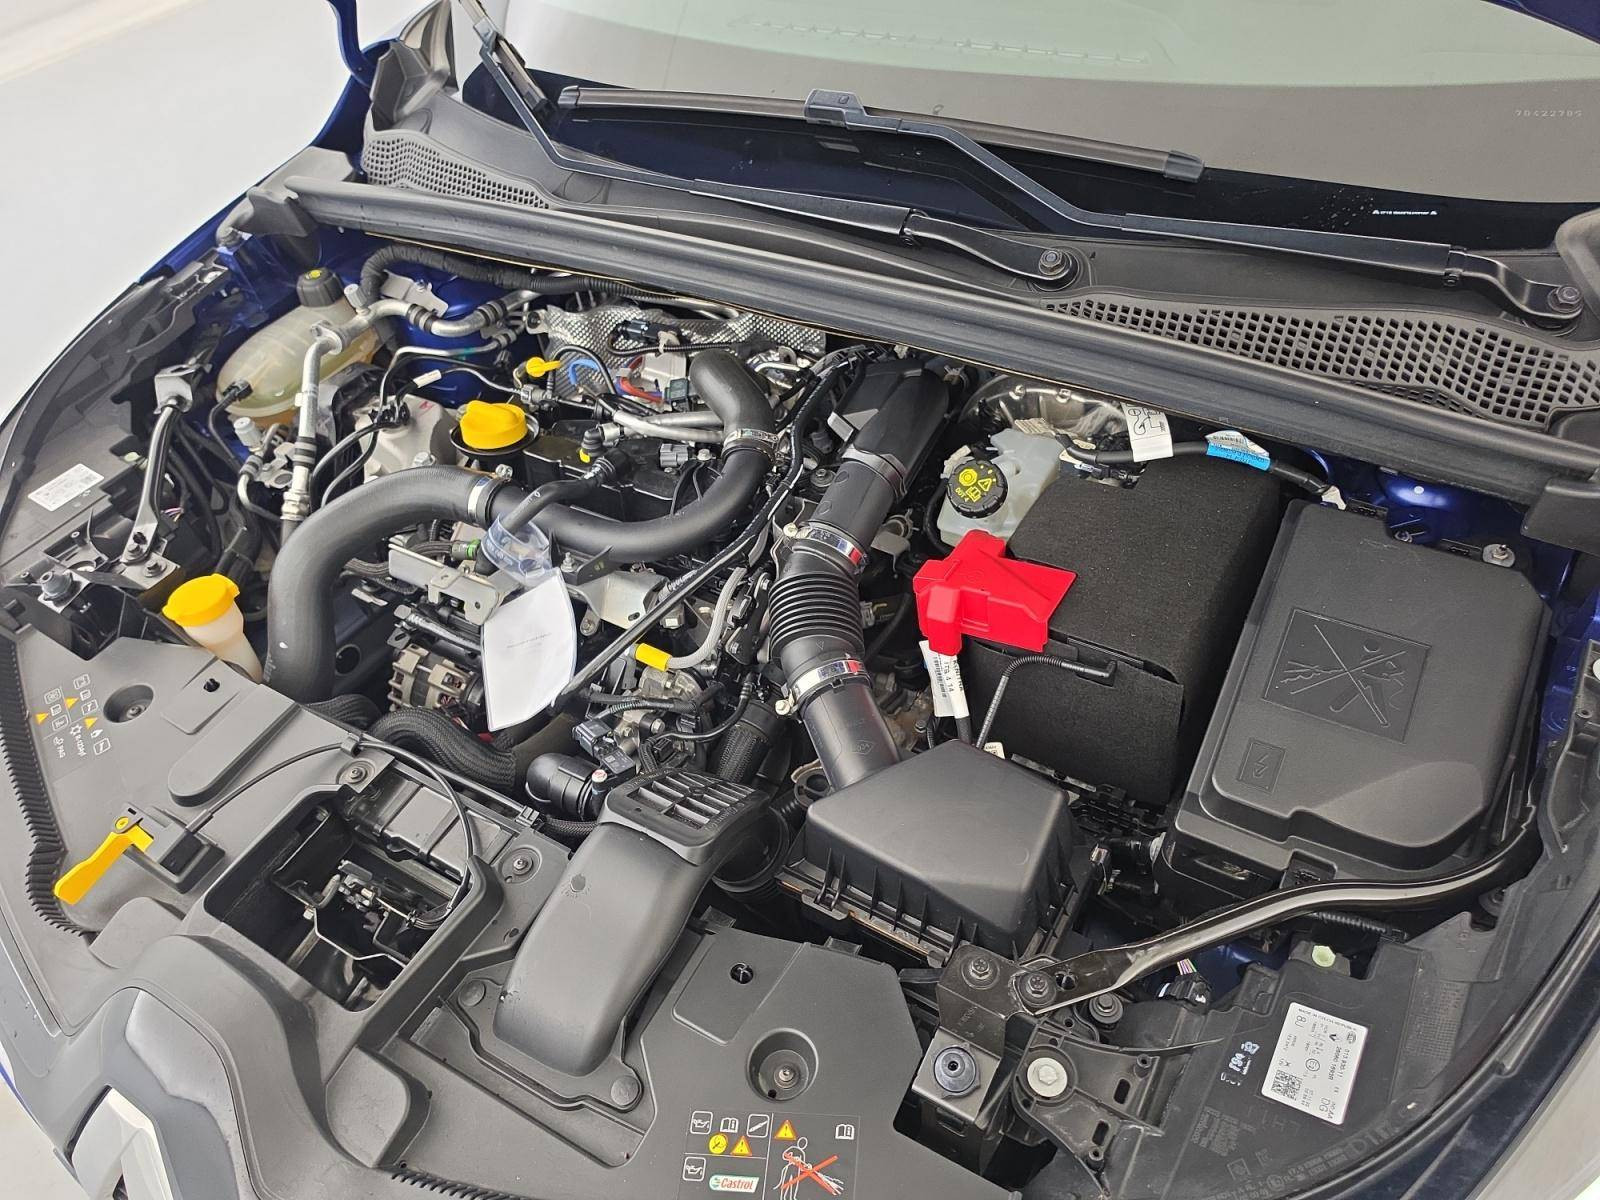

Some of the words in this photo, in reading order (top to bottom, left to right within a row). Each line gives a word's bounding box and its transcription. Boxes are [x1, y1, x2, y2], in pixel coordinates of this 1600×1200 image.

[955, 487, 966, 498] DOT
[1319, 1097, 1331, 1112] DG
[720, 1177, 754, 1190] Castrol
